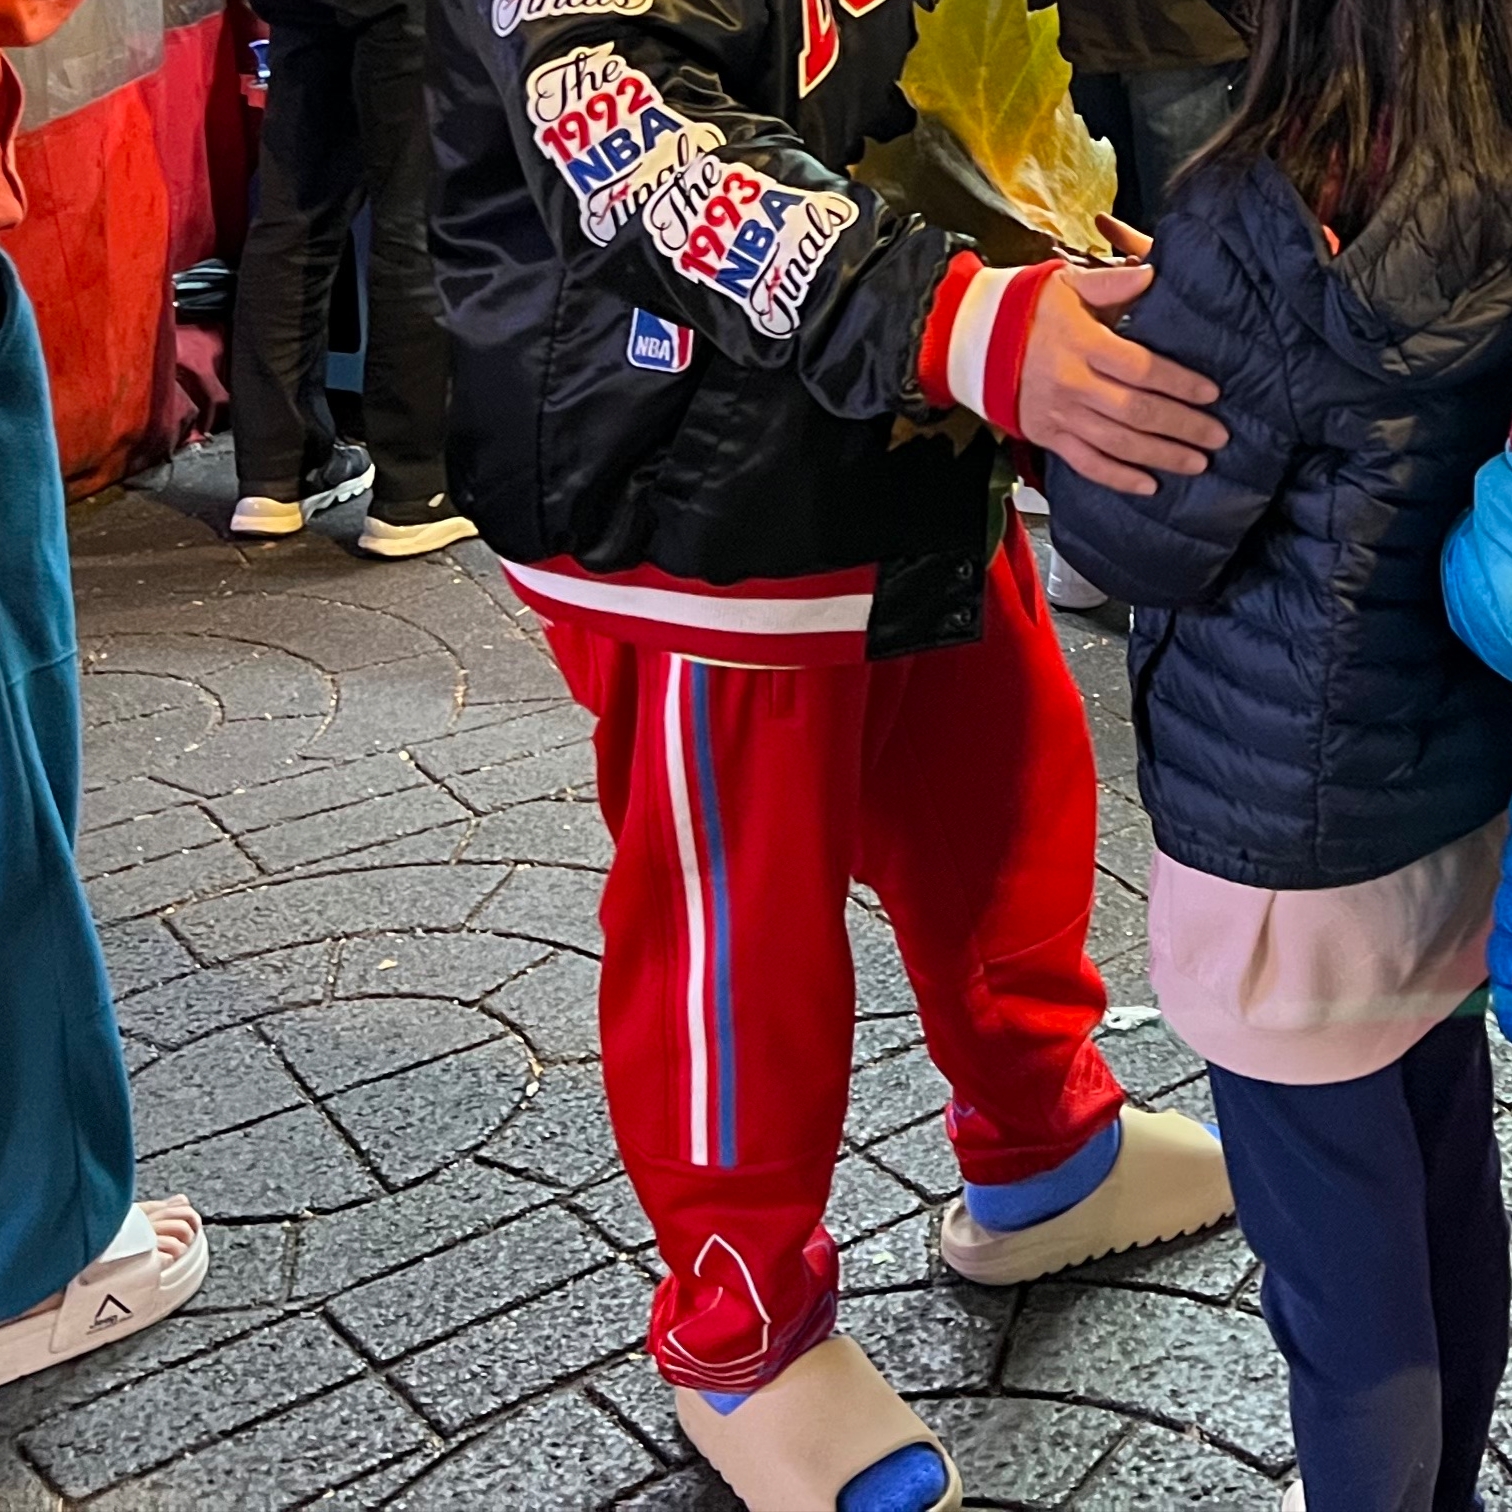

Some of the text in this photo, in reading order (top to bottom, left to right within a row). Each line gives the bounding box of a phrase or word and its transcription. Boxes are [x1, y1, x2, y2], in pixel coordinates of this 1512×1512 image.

[535, 51, 624, 122] The
[542, 76, 654, 163] 1992
[566, 106, 684, 195] NBA
[650, 160, 723, 251] The
[679, 172, 762, 280] 1993
[714, 189, 807, 299] NBA
[749, 196, 853, 335] Finals
[634, 334, 673, 363] NBA
